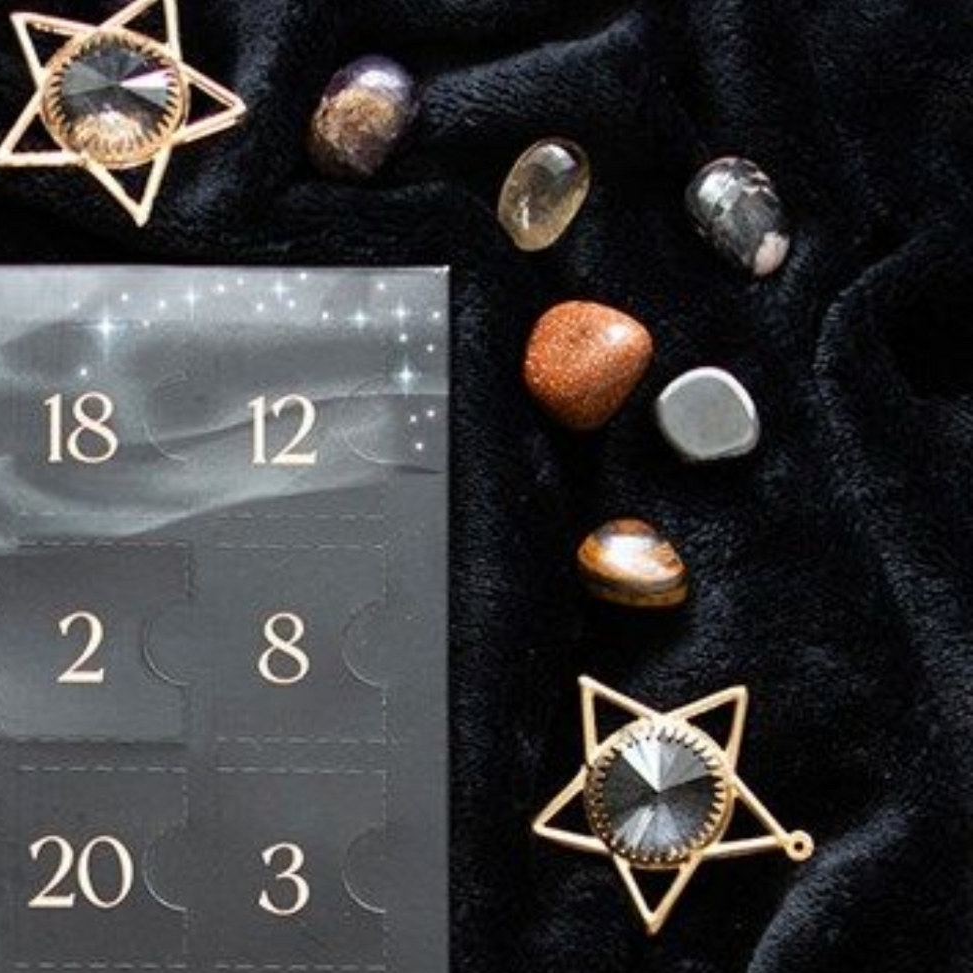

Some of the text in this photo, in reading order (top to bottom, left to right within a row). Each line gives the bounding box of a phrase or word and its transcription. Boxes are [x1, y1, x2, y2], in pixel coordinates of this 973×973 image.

[44, 391, 118, 464] 18
[247, 393, 317, 464] 12
[57, 611, 105, 683] 2
[258, 612, 310, 684] 8
[27, 835, 134, 909] 20
[258, 842, 310, 916] 3
